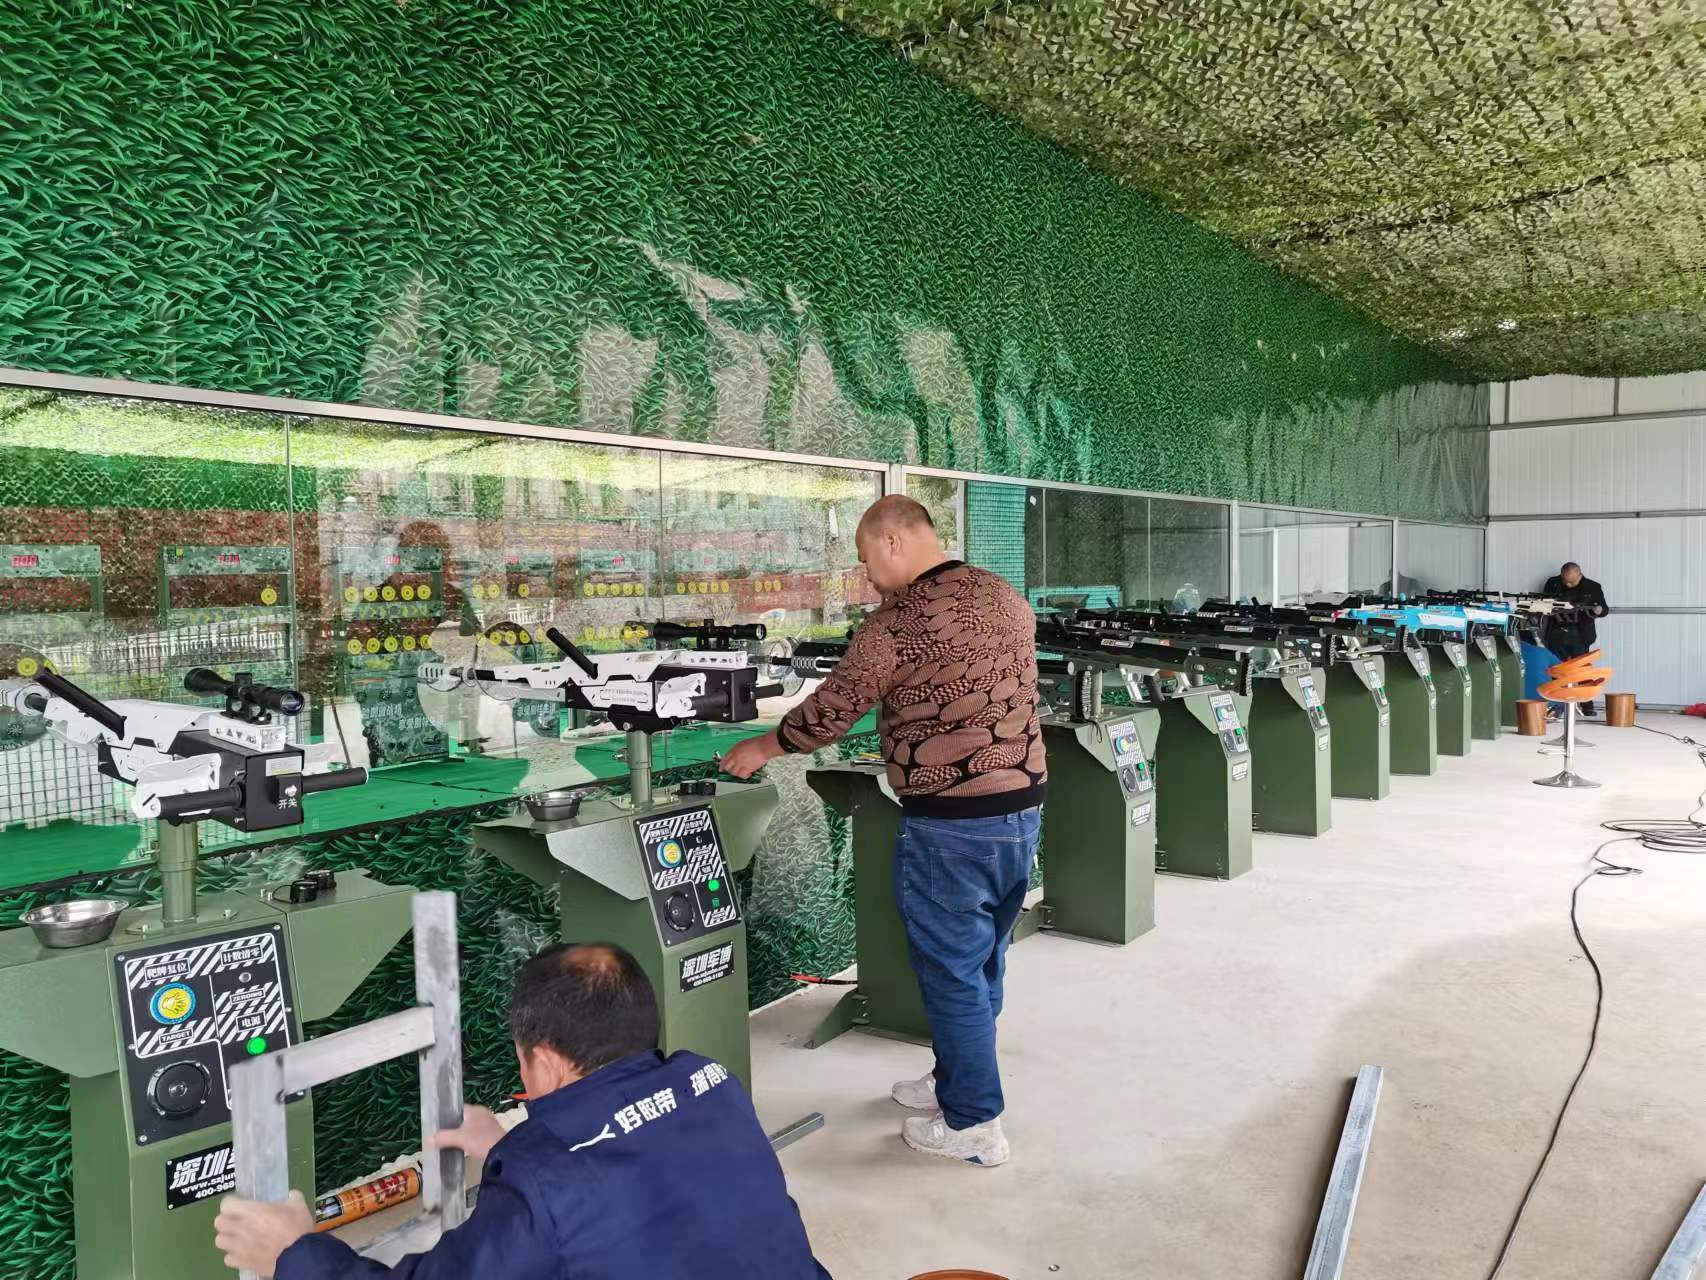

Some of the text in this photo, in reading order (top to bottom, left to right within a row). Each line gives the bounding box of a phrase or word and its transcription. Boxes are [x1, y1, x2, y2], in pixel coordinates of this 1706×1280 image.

[278, 798, 297, 809] 开关
[681, 945, 733, 979] 深圳军博
[242, 1015, 261, 1027] 电源
[162, 1032, 191, 1043] TARGET
[169, 1148, 236, 1190] 深圳
